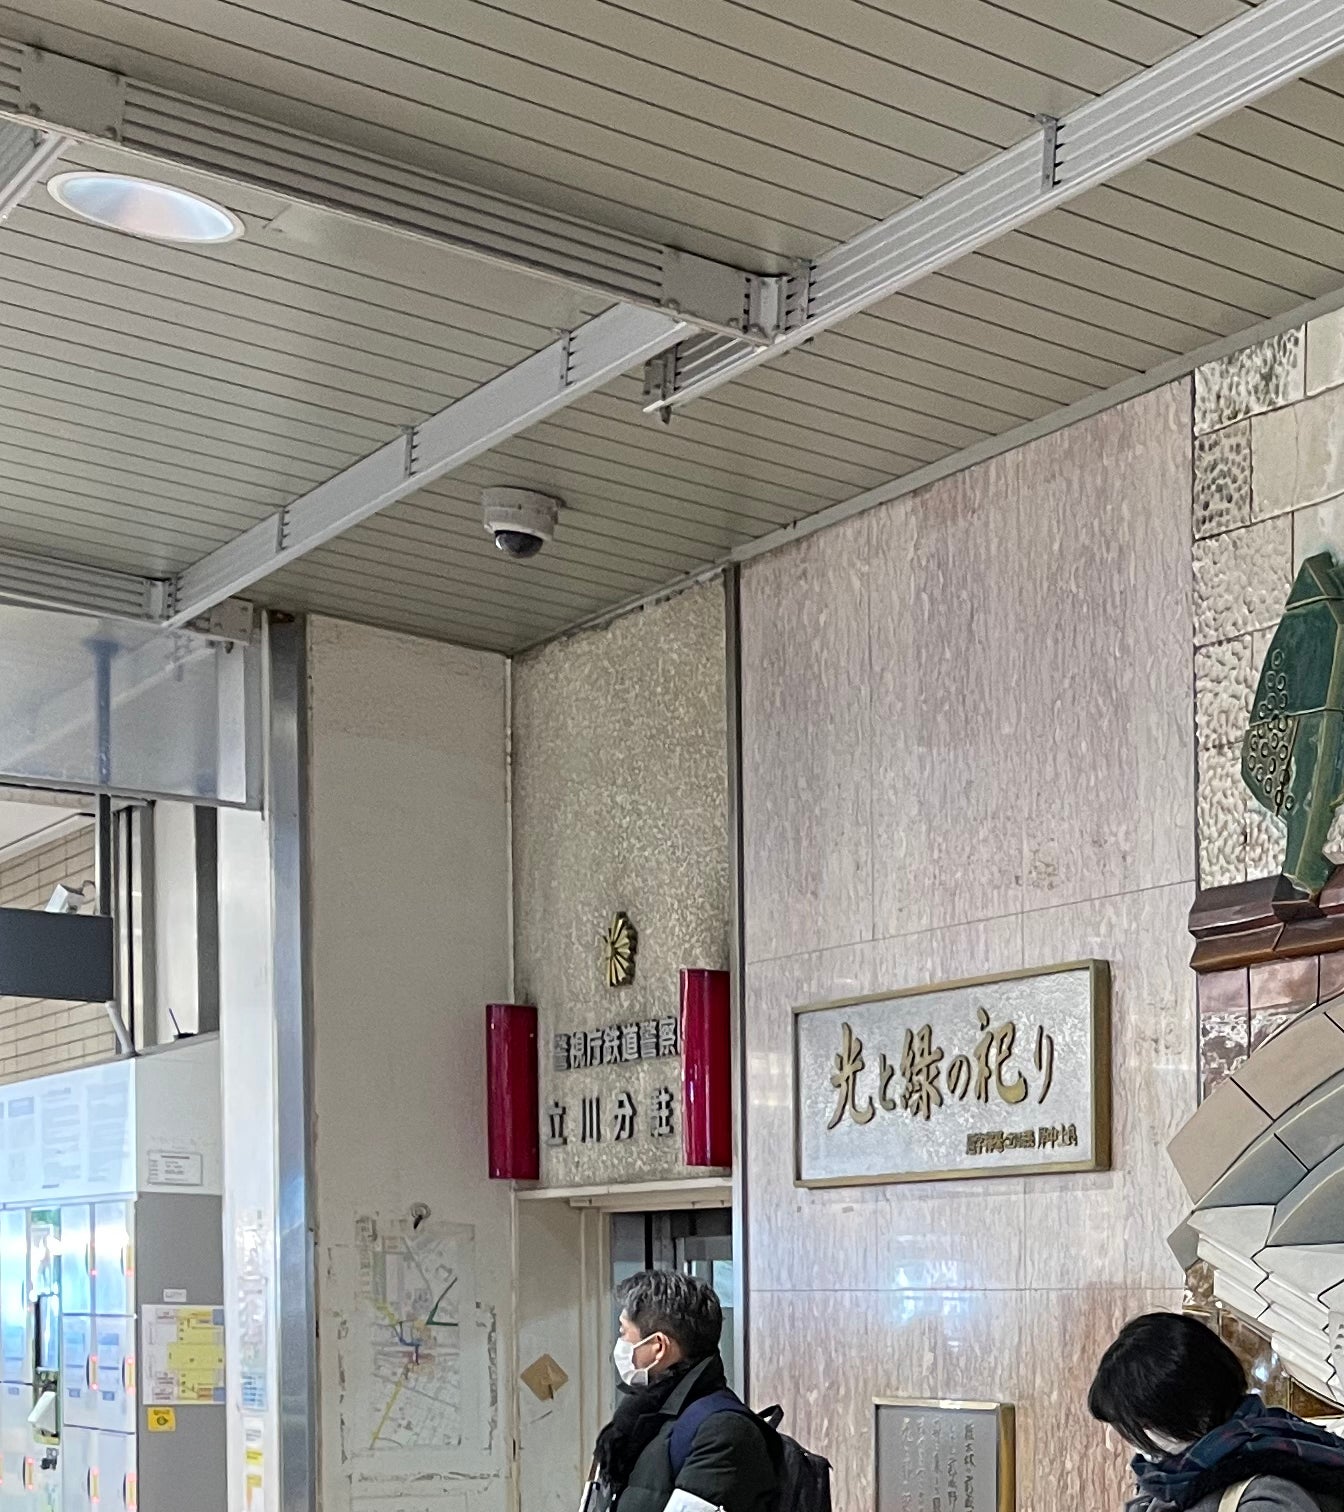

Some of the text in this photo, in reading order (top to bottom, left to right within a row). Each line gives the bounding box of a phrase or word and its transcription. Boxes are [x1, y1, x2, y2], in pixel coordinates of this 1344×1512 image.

[553, 1016, 680, 1071] 警視庁鉄道警察
